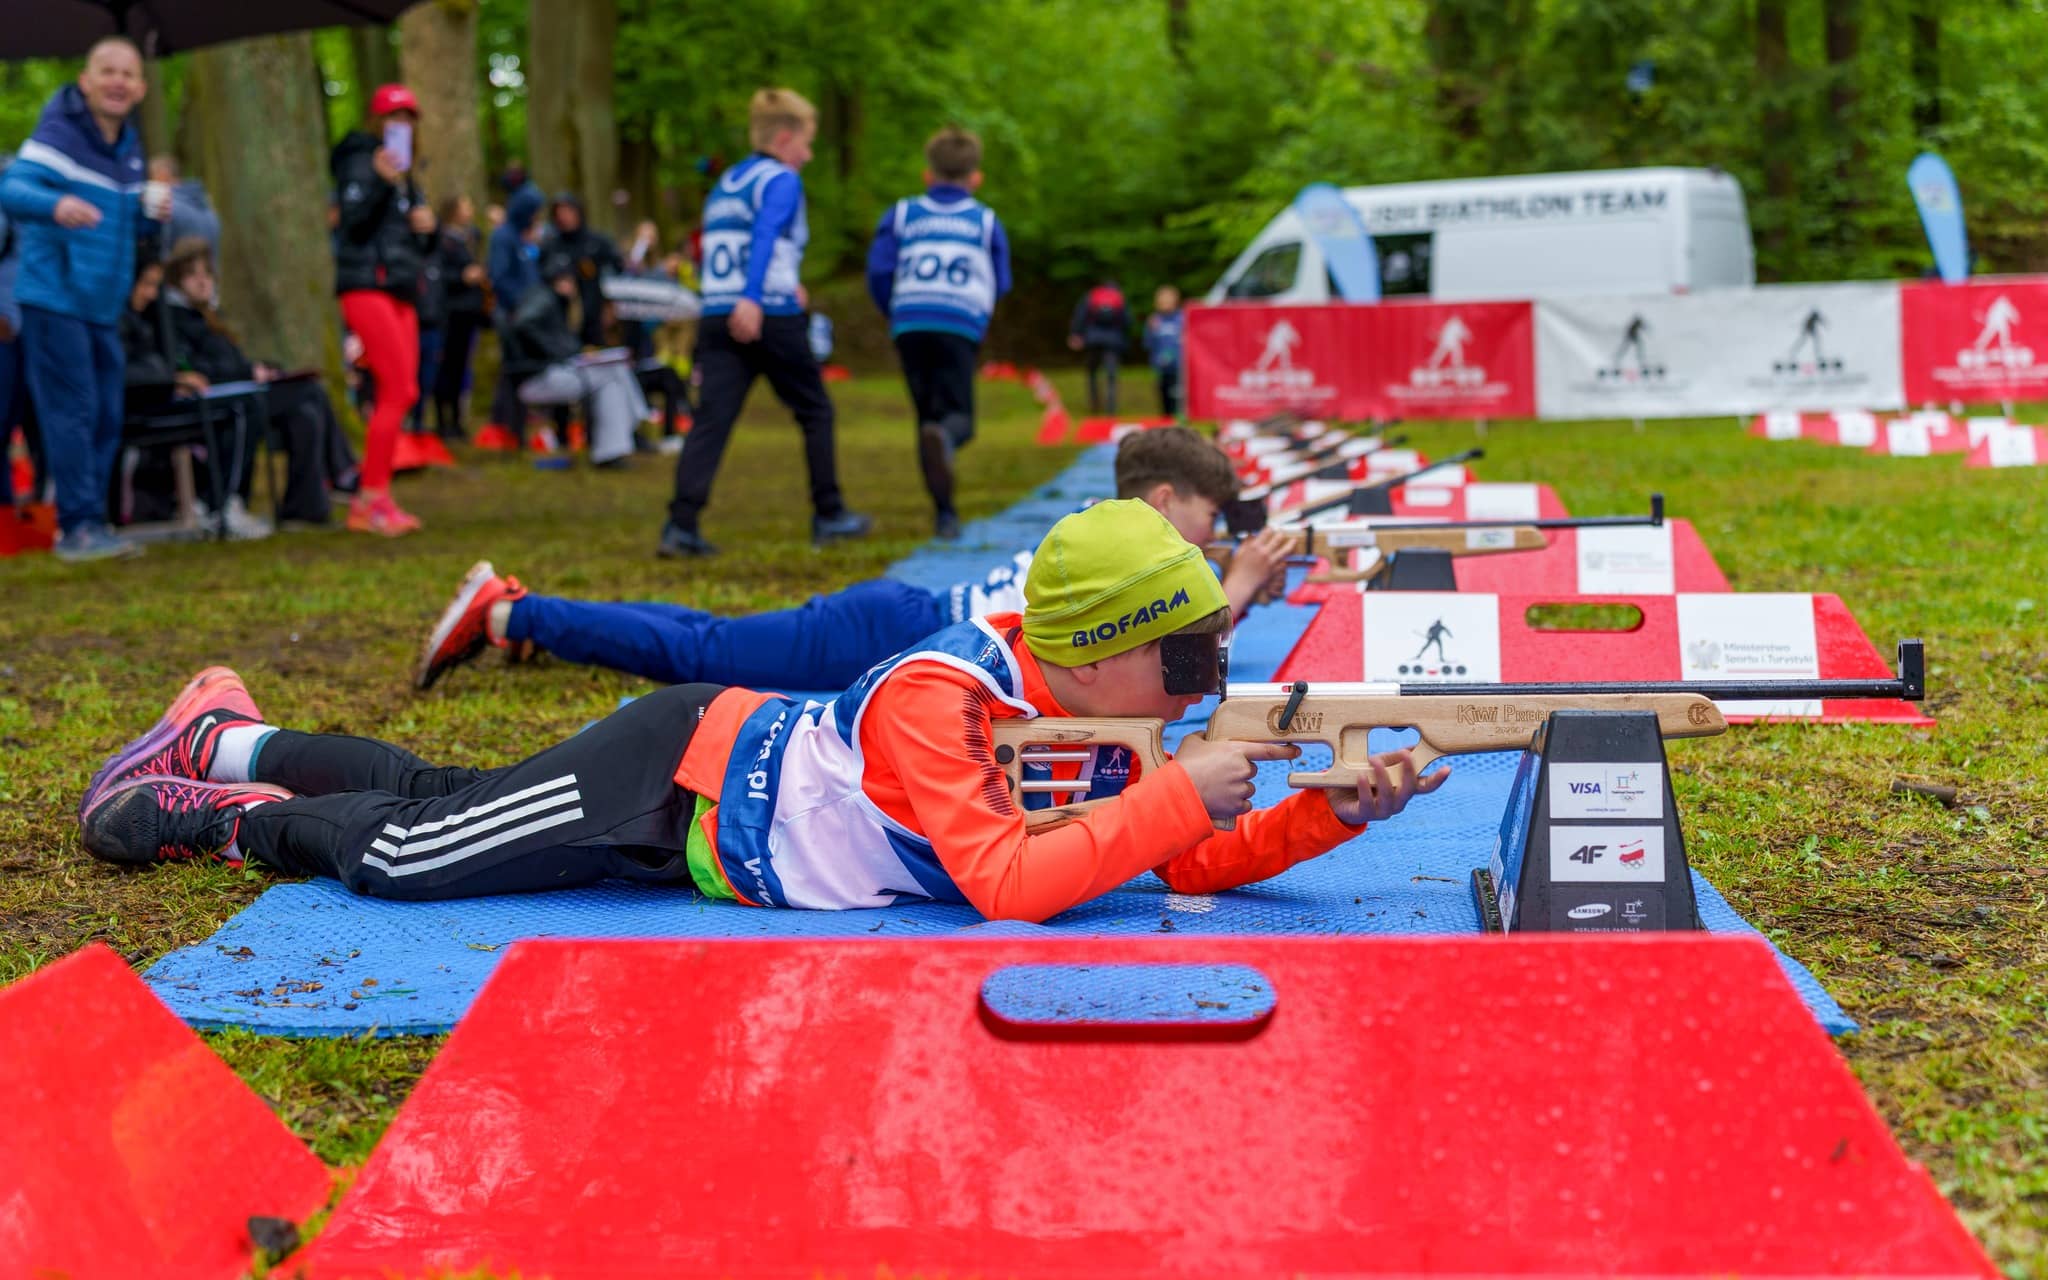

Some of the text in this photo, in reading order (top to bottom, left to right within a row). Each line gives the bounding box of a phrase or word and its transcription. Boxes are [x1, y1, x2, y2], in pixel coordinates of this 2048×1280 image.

[1425, 195, 1573, 222] BIATHLON
[1581, 189, 1668, 215] TEAM
[1072, 587, 1190, 648] BIOFARM
[1724, 641, 1791, 652] Ministerstwo
[1569, 782, 1602, 794] VISA
[1569, 845, 1608, 864] 4F
